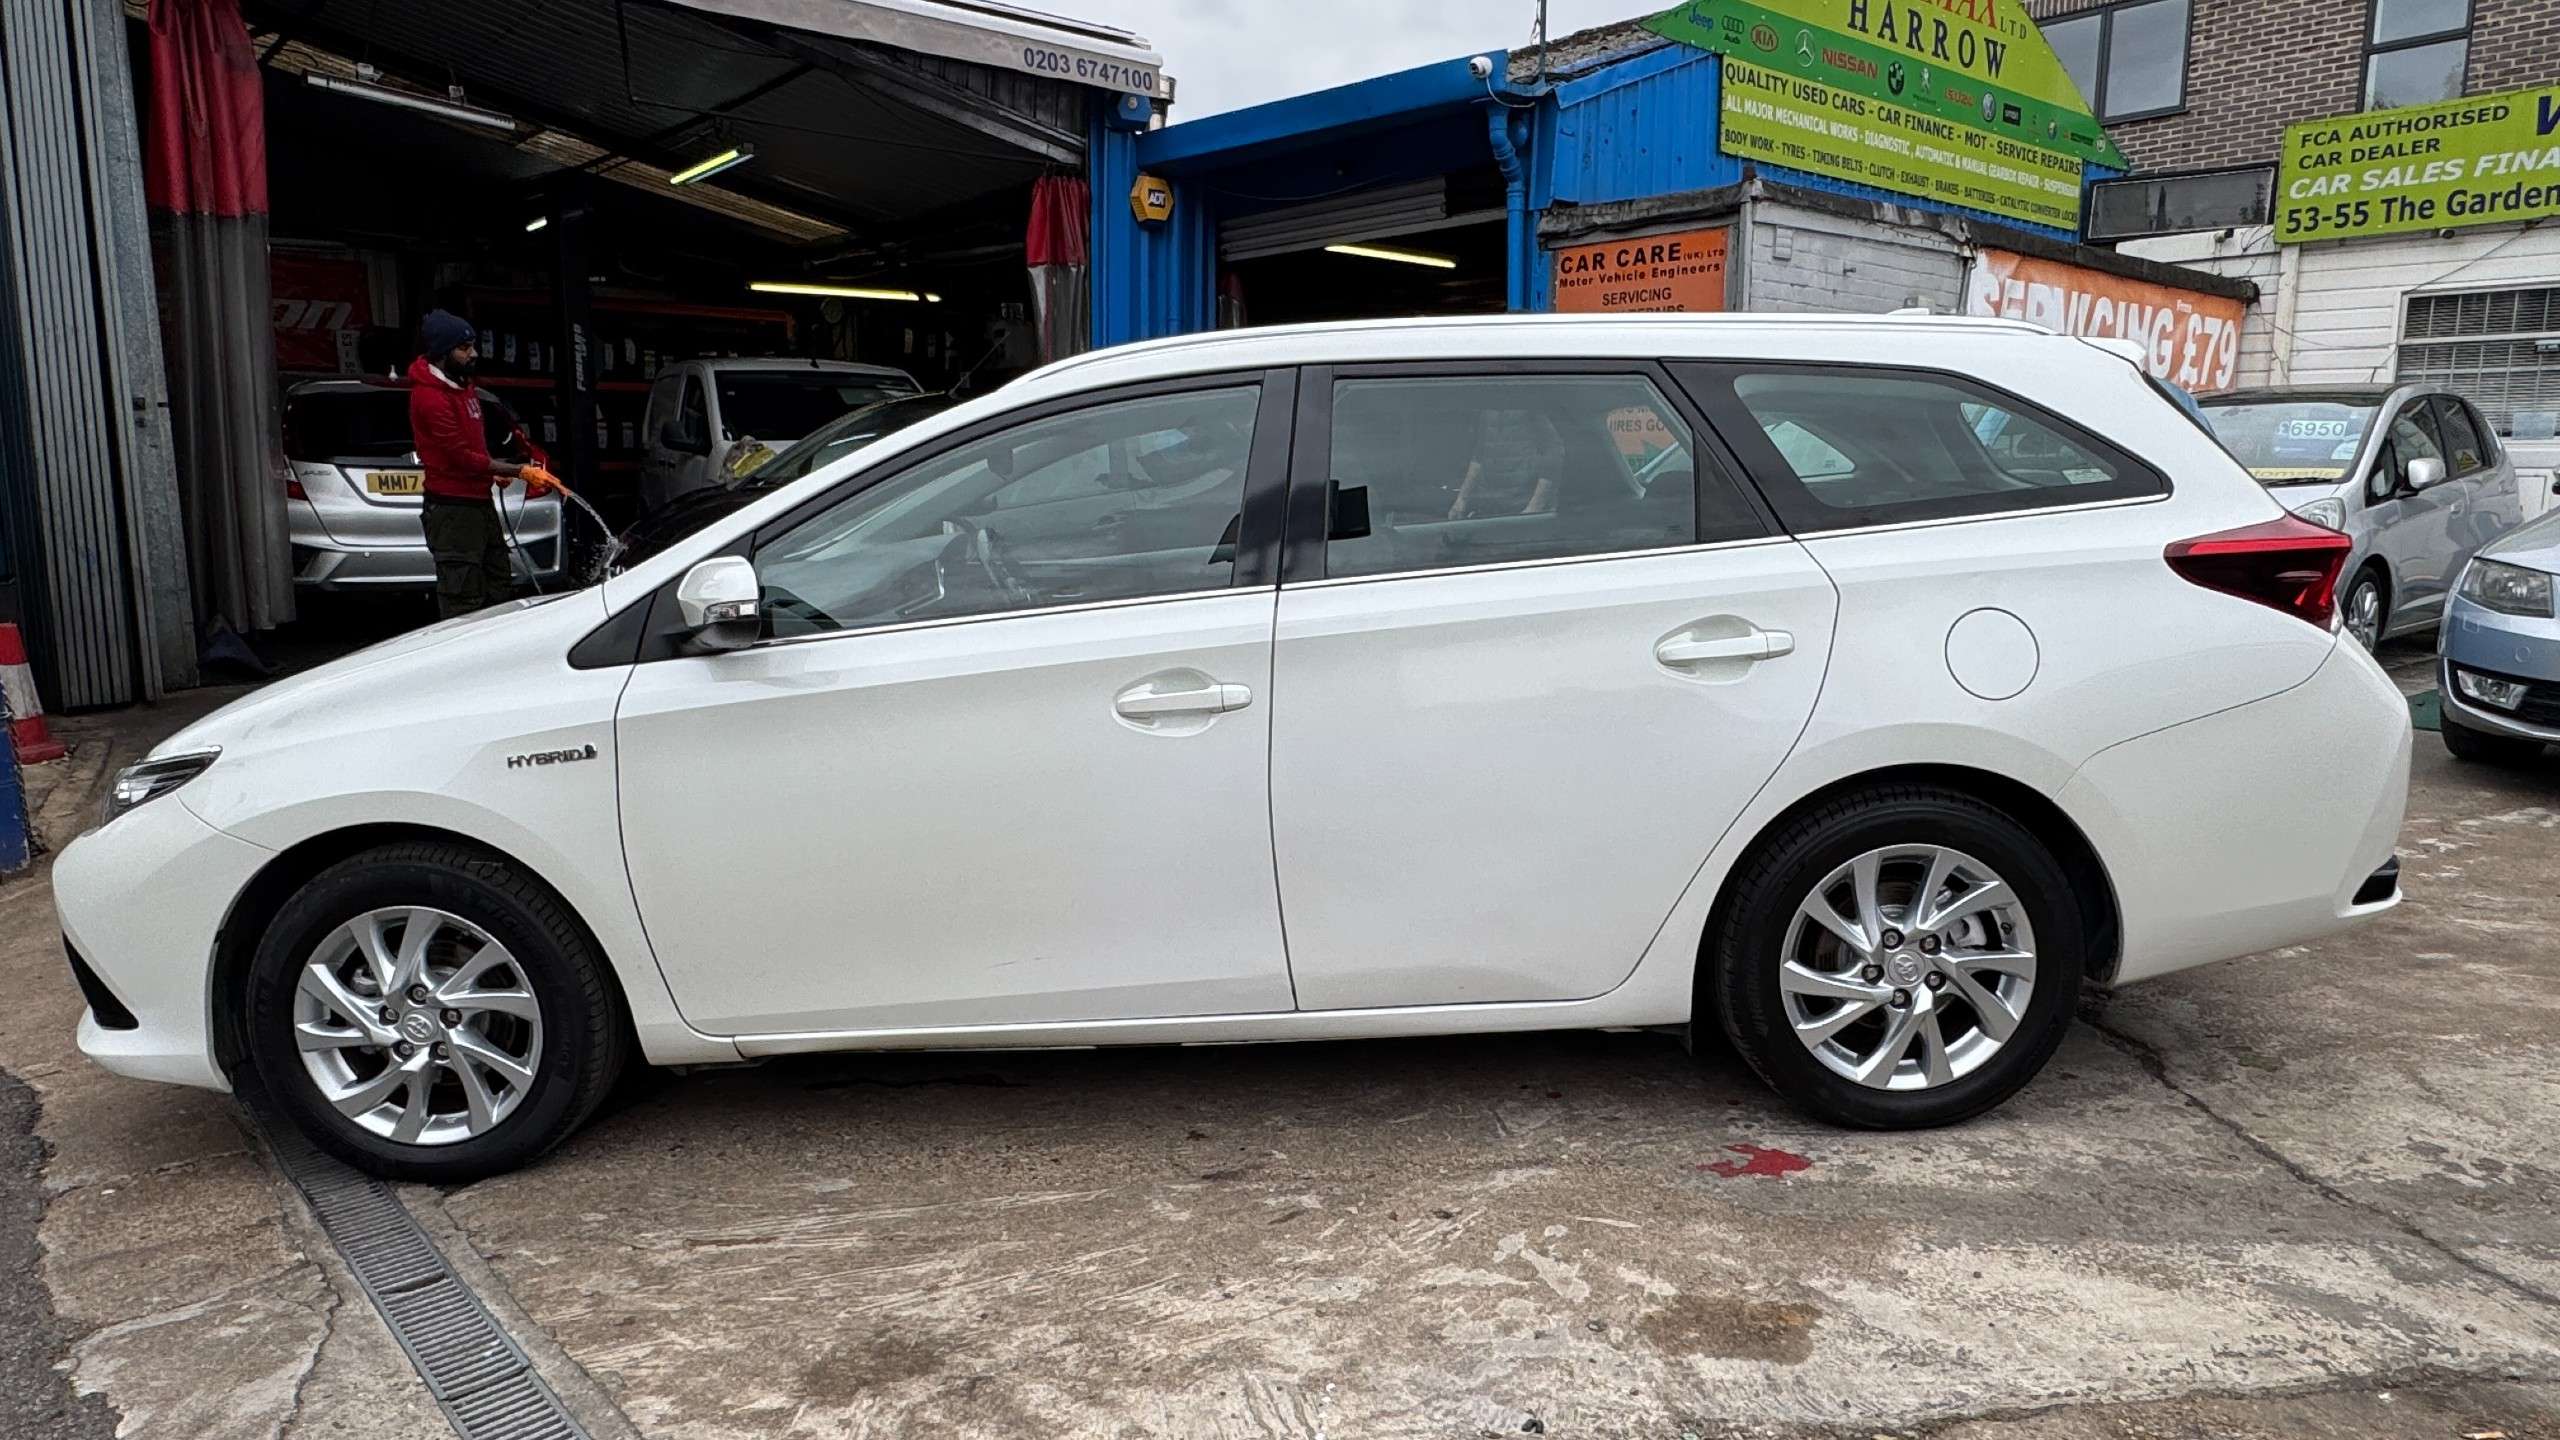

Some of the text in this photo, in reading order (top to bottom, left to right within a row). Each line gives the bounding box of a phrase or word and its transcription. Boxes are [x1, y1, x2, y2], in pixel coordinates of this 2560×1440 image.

[1688, 5, 1714, 31] Jeep
[2000, 15, 2027, 39] LTD
[1848, 0, 2007, 79] HARROW
[1024, 47, 1153, 91] 0203 6747100
[1822, 47, 1879, 79] NISSAN
[1725, 62, 2080, 176] QUALITY USED CARS CAR FINANCE MOT SERVICE REPAIRS
[1726, 93, 1743, 113] ALL
[1744, 98, 1774, 120] MAJOR
[1775, 107, 1828, 136] MECHANICAL
[1830, 122, 1859, 143] WORKS
[2301, 105, 2510, 149] FCA AUTHORISED
[1724, 128, 1749, 147] BODY
[1750, 133, 1775, 153] WORK
[1781, 142, 1806, 160] TYRES
[1812, 149, 1840, 168] TIMING
[1841, 156, 1863, 173] BELTS
[1869, 162, 1895, 181] CLUTCH
[1901, 170, 1929, 189] EXHAUST
[2298, 138, 2441, 169] CAR DEALER
[2289, 174, 2352, 200] CAR
[2360, 158, 2465, 191] SALES
[2285, 200, 2370, 234] 53-55
[2380, 195, 2435, 224] The
[1559, 262, 1721, 289] Motor Vehicle Engineers
[1560, 252, 1605, 274] CAR
[1616, 242, 1682, 268] CARE
[1706, 248, 1725, 258] LTD
[1601, 287, 1672, 306] SERVICING
[2177, 312, 2237, 389] £79
[377, 474, 419, 491] MM17
[507, 748, 582, 769] HYBRID
